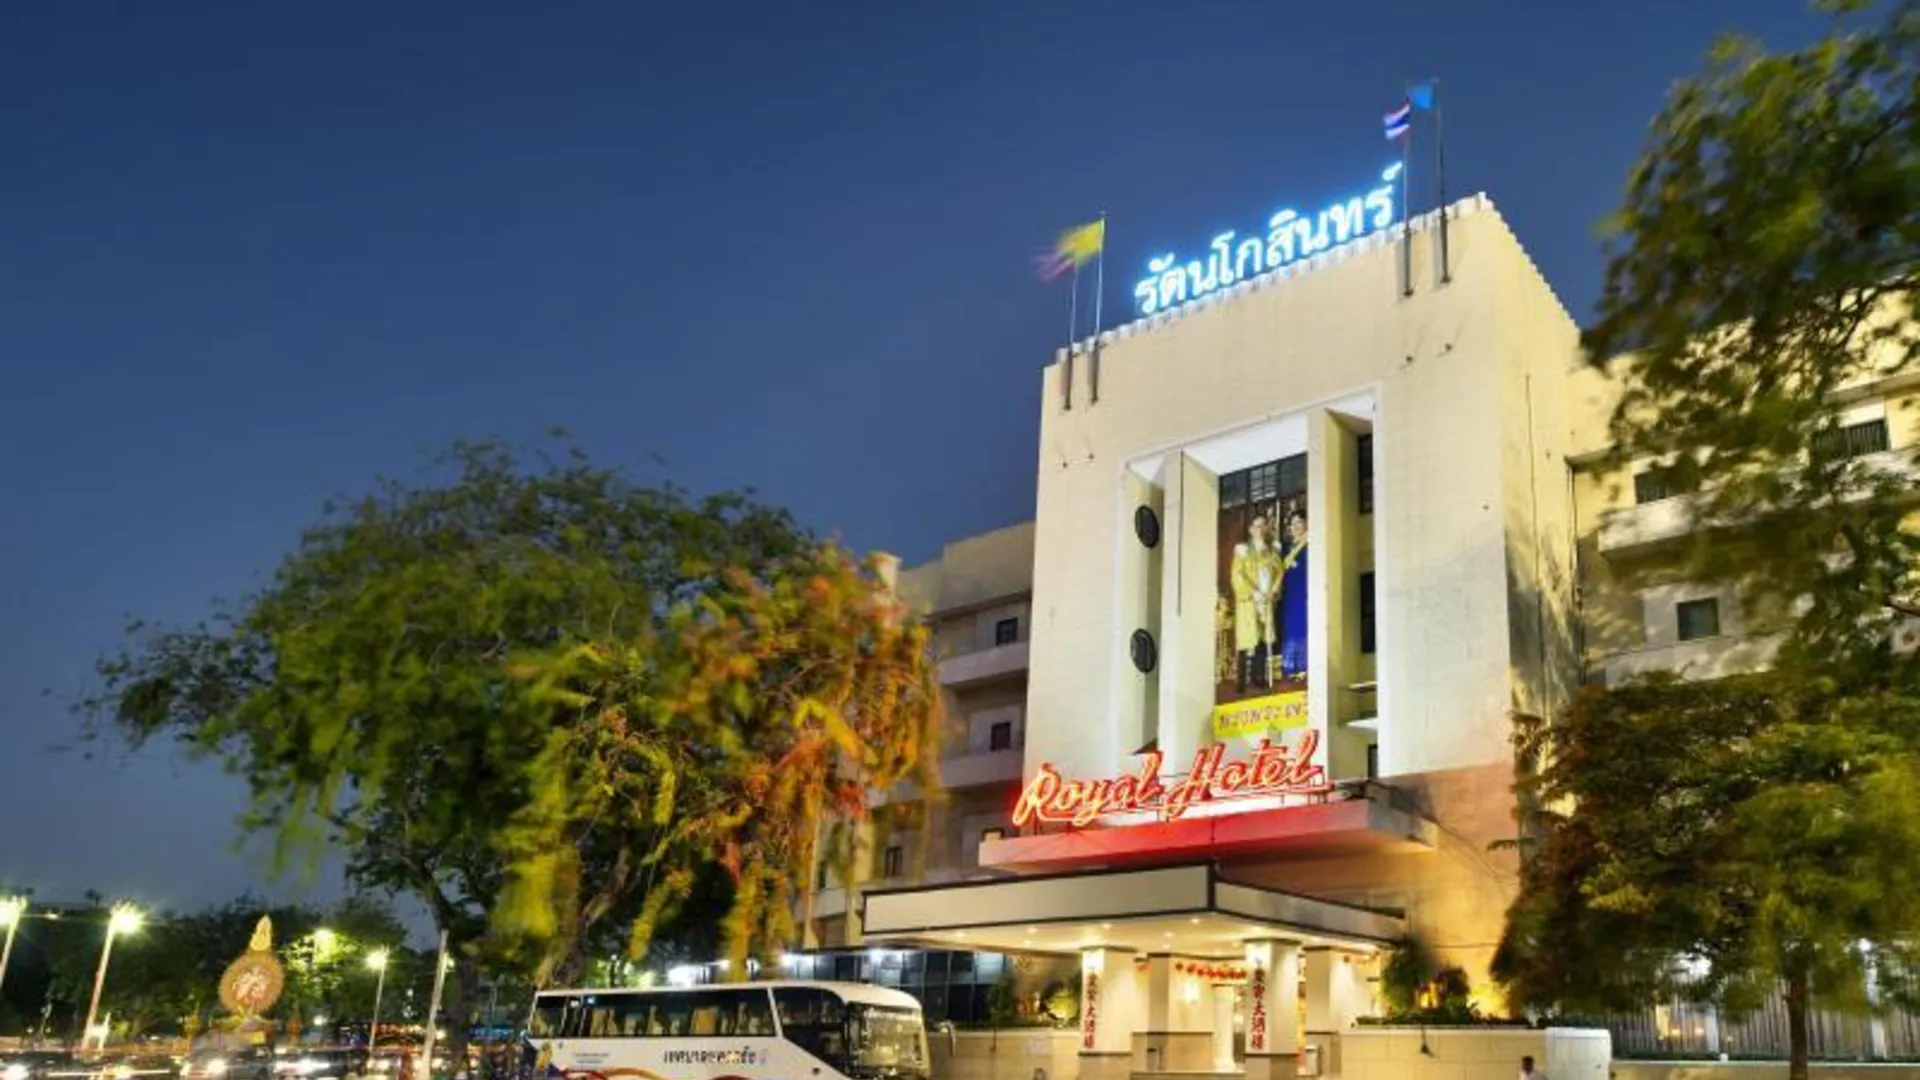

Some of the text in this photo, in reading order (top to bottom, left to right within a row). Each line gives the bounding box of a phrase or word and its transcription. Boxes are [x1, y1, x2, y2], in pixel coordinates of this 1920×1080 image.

[1134, 161, 1403, 314] รัตนโกสินทร์
[1012, 729, 1323, 827] Royal Hotel
